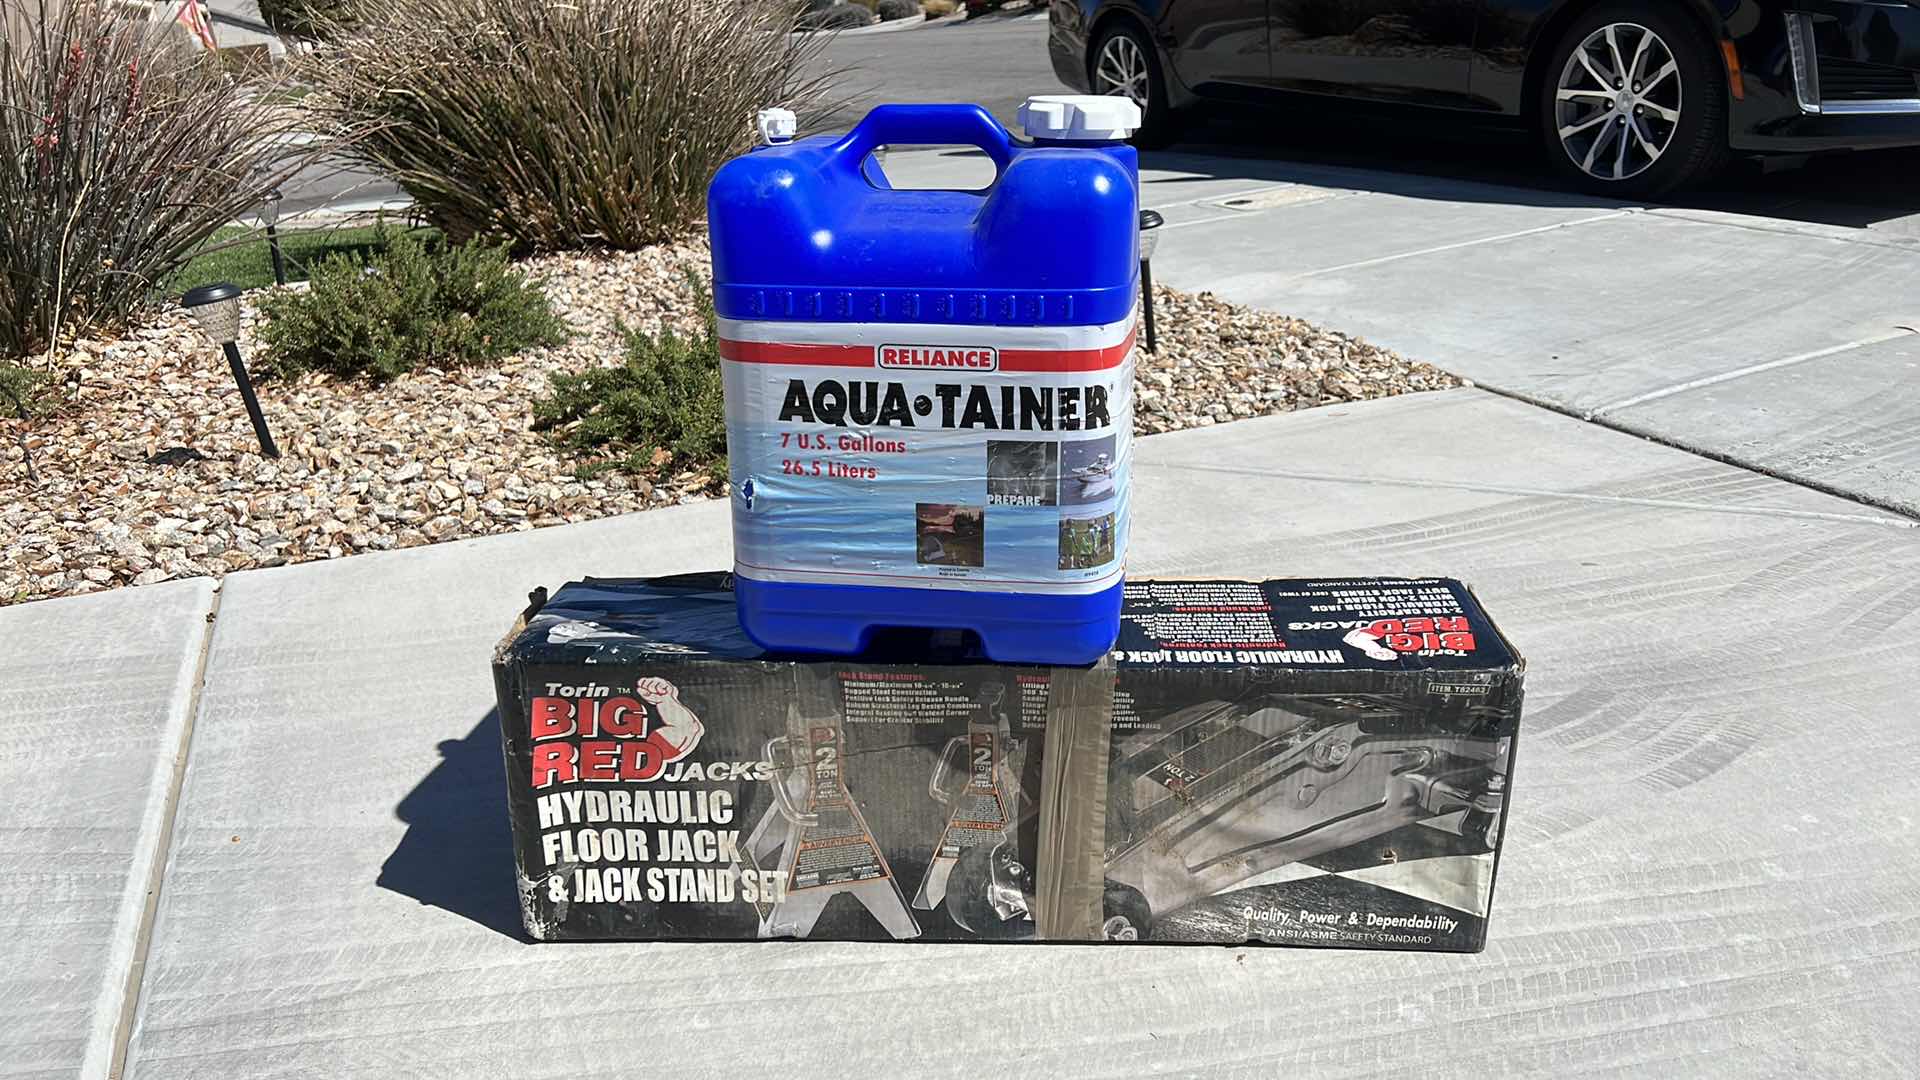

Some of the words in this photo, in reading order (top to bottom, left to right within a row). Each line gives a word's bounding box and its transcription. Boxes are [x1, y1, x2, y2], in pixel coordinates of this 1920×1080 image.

[883, 348, 992, 368] RELIANCE
[781, 433, 789, 449] 7
[798, 434, 833, 452] U.S.
[838, 435, 906, 453] Gallons
[782, 459, 822, 477] 26.5
[828, 460, 876, 479] Liters
[987, 494, 1041, 506] PREPARE
[1331, 589, 1381, 597] STANDS
[1337, 596, 1377, 604] HEAVY
[1379, 595, 1418, 603] 2-TON
[1420, 594, 1456, 602] WITH
[1310, 604, 1342, 612] JACK
[1345, 602, 1385, 610] FLOOR
[1358, 608, 1422, 617] CAPACITY
[1386, 601, 1460, 609] HYDRAULIC
[1287, 621, 1371, 631] JACKS
[1369, 616, 1471, 633] RED
[1385, 632, 1477, 652] BIG
[1127, 649, 1173, 664] JACK
[1175, 650, 1235, 664] FLOOR
[1236, 650, 1345, 664] HYDRAULIC
[1417, 649, 1468, 657] Torin
[545, 682, 610, 697] Torin
[531, 696, 648, 741] BIG
[816, 748, 837, 771] 2
[973, 747, 992, 764] 2
[531, 741, 665, 789] RED
[664, 761, 775, 782] JACKS
[1163, 763, 1186, 779] TON
[815, 770, 838, 779] TON
[537, 790, 733, 829] HYDRAULIC
[542, 828, 649, 866] FLOOR
[656, 829, 743, 864] JACK
[547, 874, 570, 902] &
[574, 868, 642, 902] JACK
[646, 868, 735, 902] STAND
[741, 869, 788, 903] SET
[1243, 907, 1293, 926] Quality,
[1300, 910, 1342, 925] Power
[1348, 911, 1359, 925] &
[1366, 912, 1459, 934] Dependability
[1268, 929, 1338, 940] ANSI/ASME
[1340, 931, 1377, 942] SAFETY
[1376, 933, 1432, 944] STANDARD
